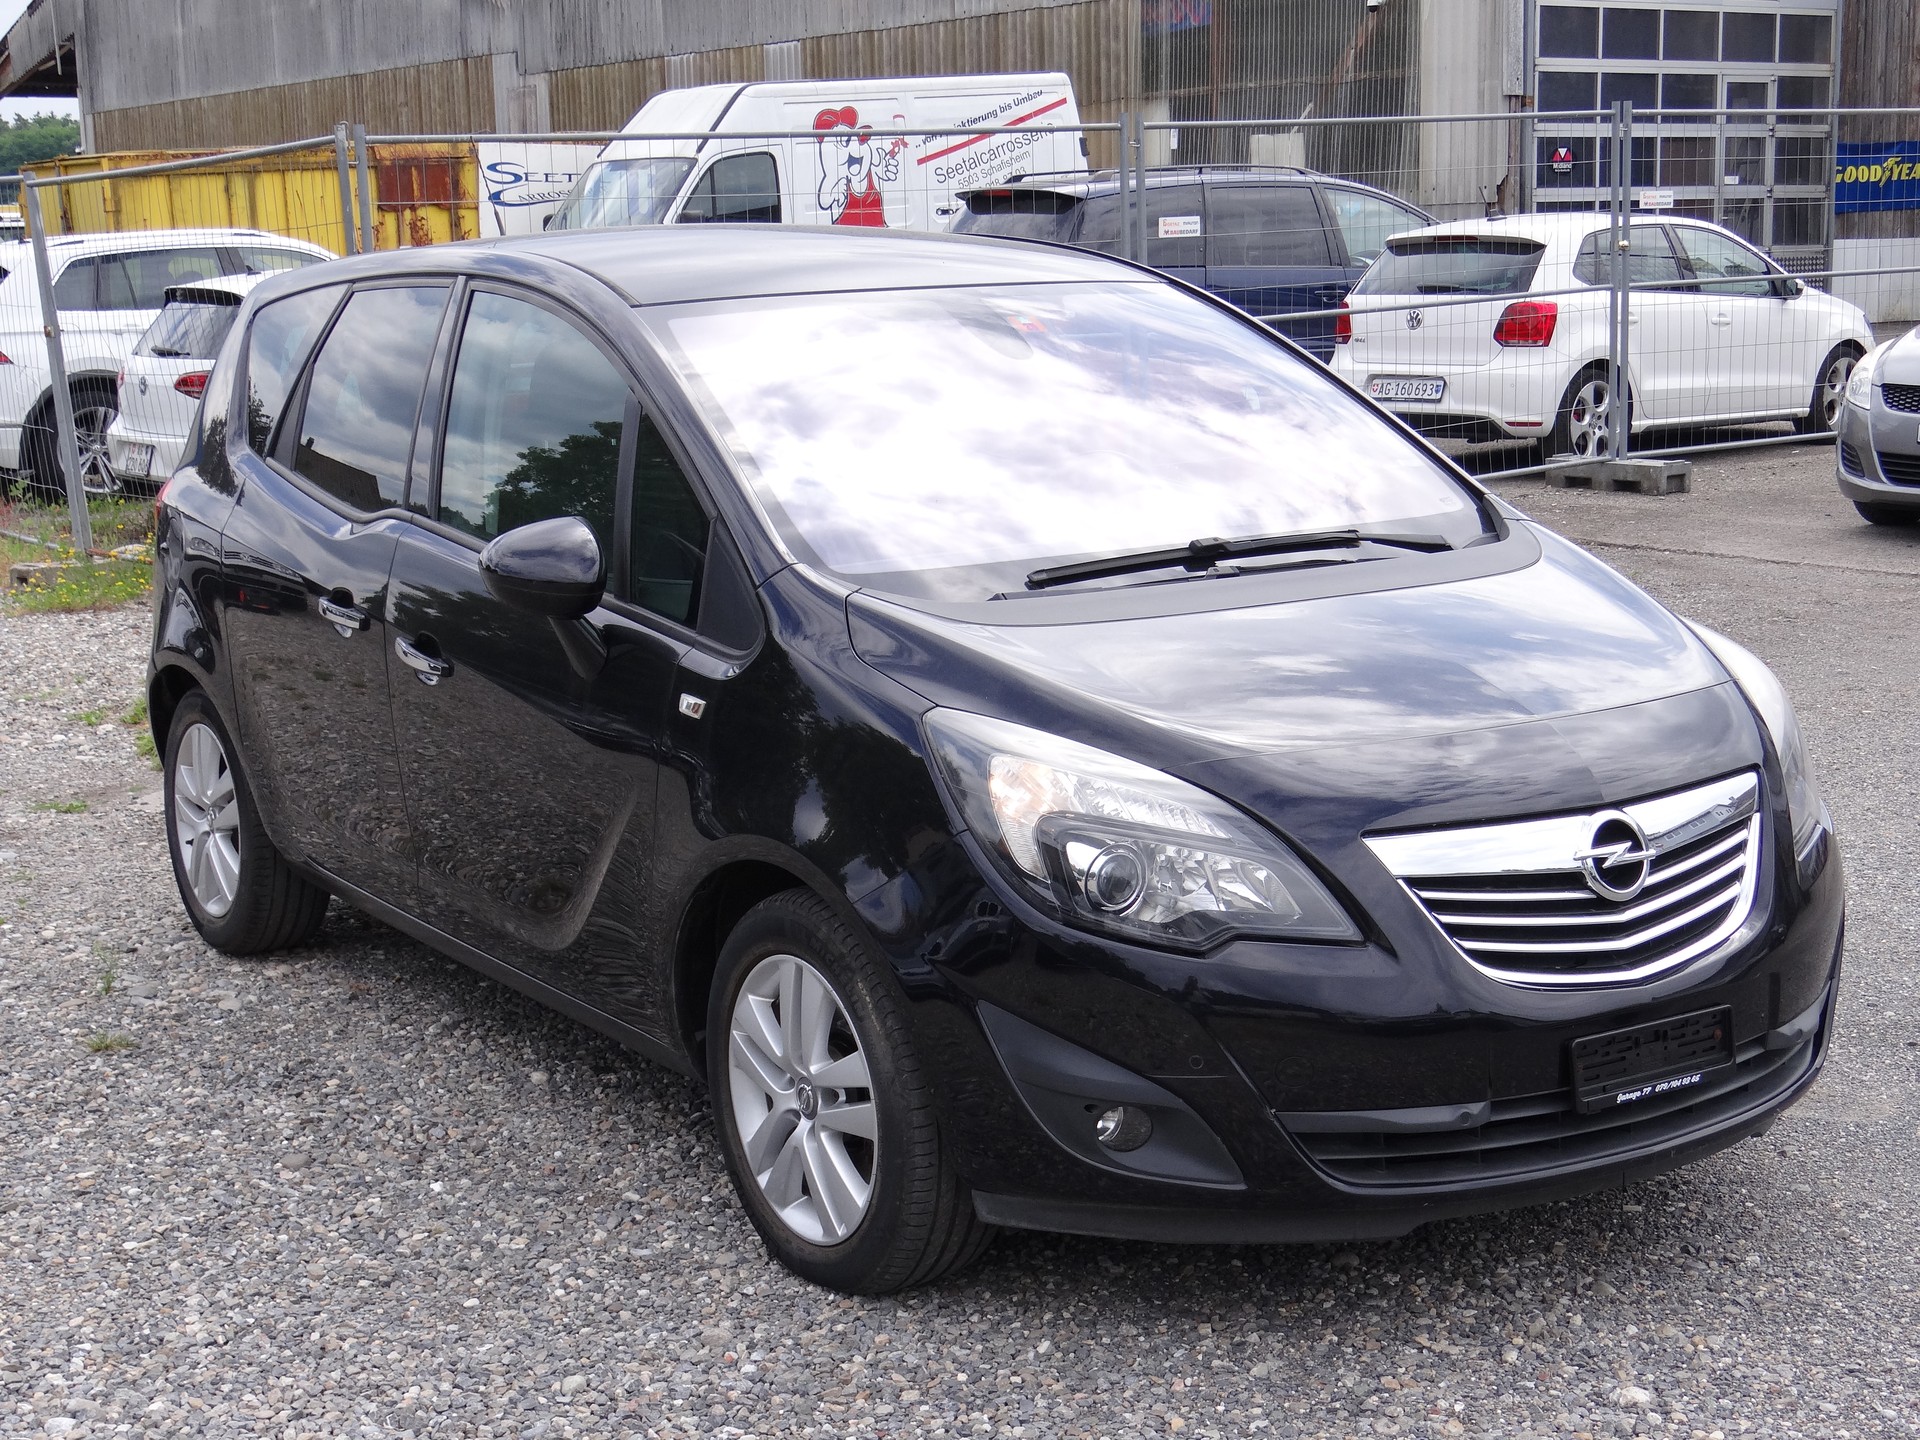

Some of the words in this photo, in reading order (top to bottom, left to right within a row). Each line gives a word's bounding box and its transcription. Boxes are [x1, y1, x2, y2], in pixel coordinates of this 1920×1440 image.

[999, 102, 1012, 114] bis
[1013, 90, 1043, 107] Umbau
[958, 172, 980, 189] 5503
[981, 150, 1031, 179] Schafisheim
